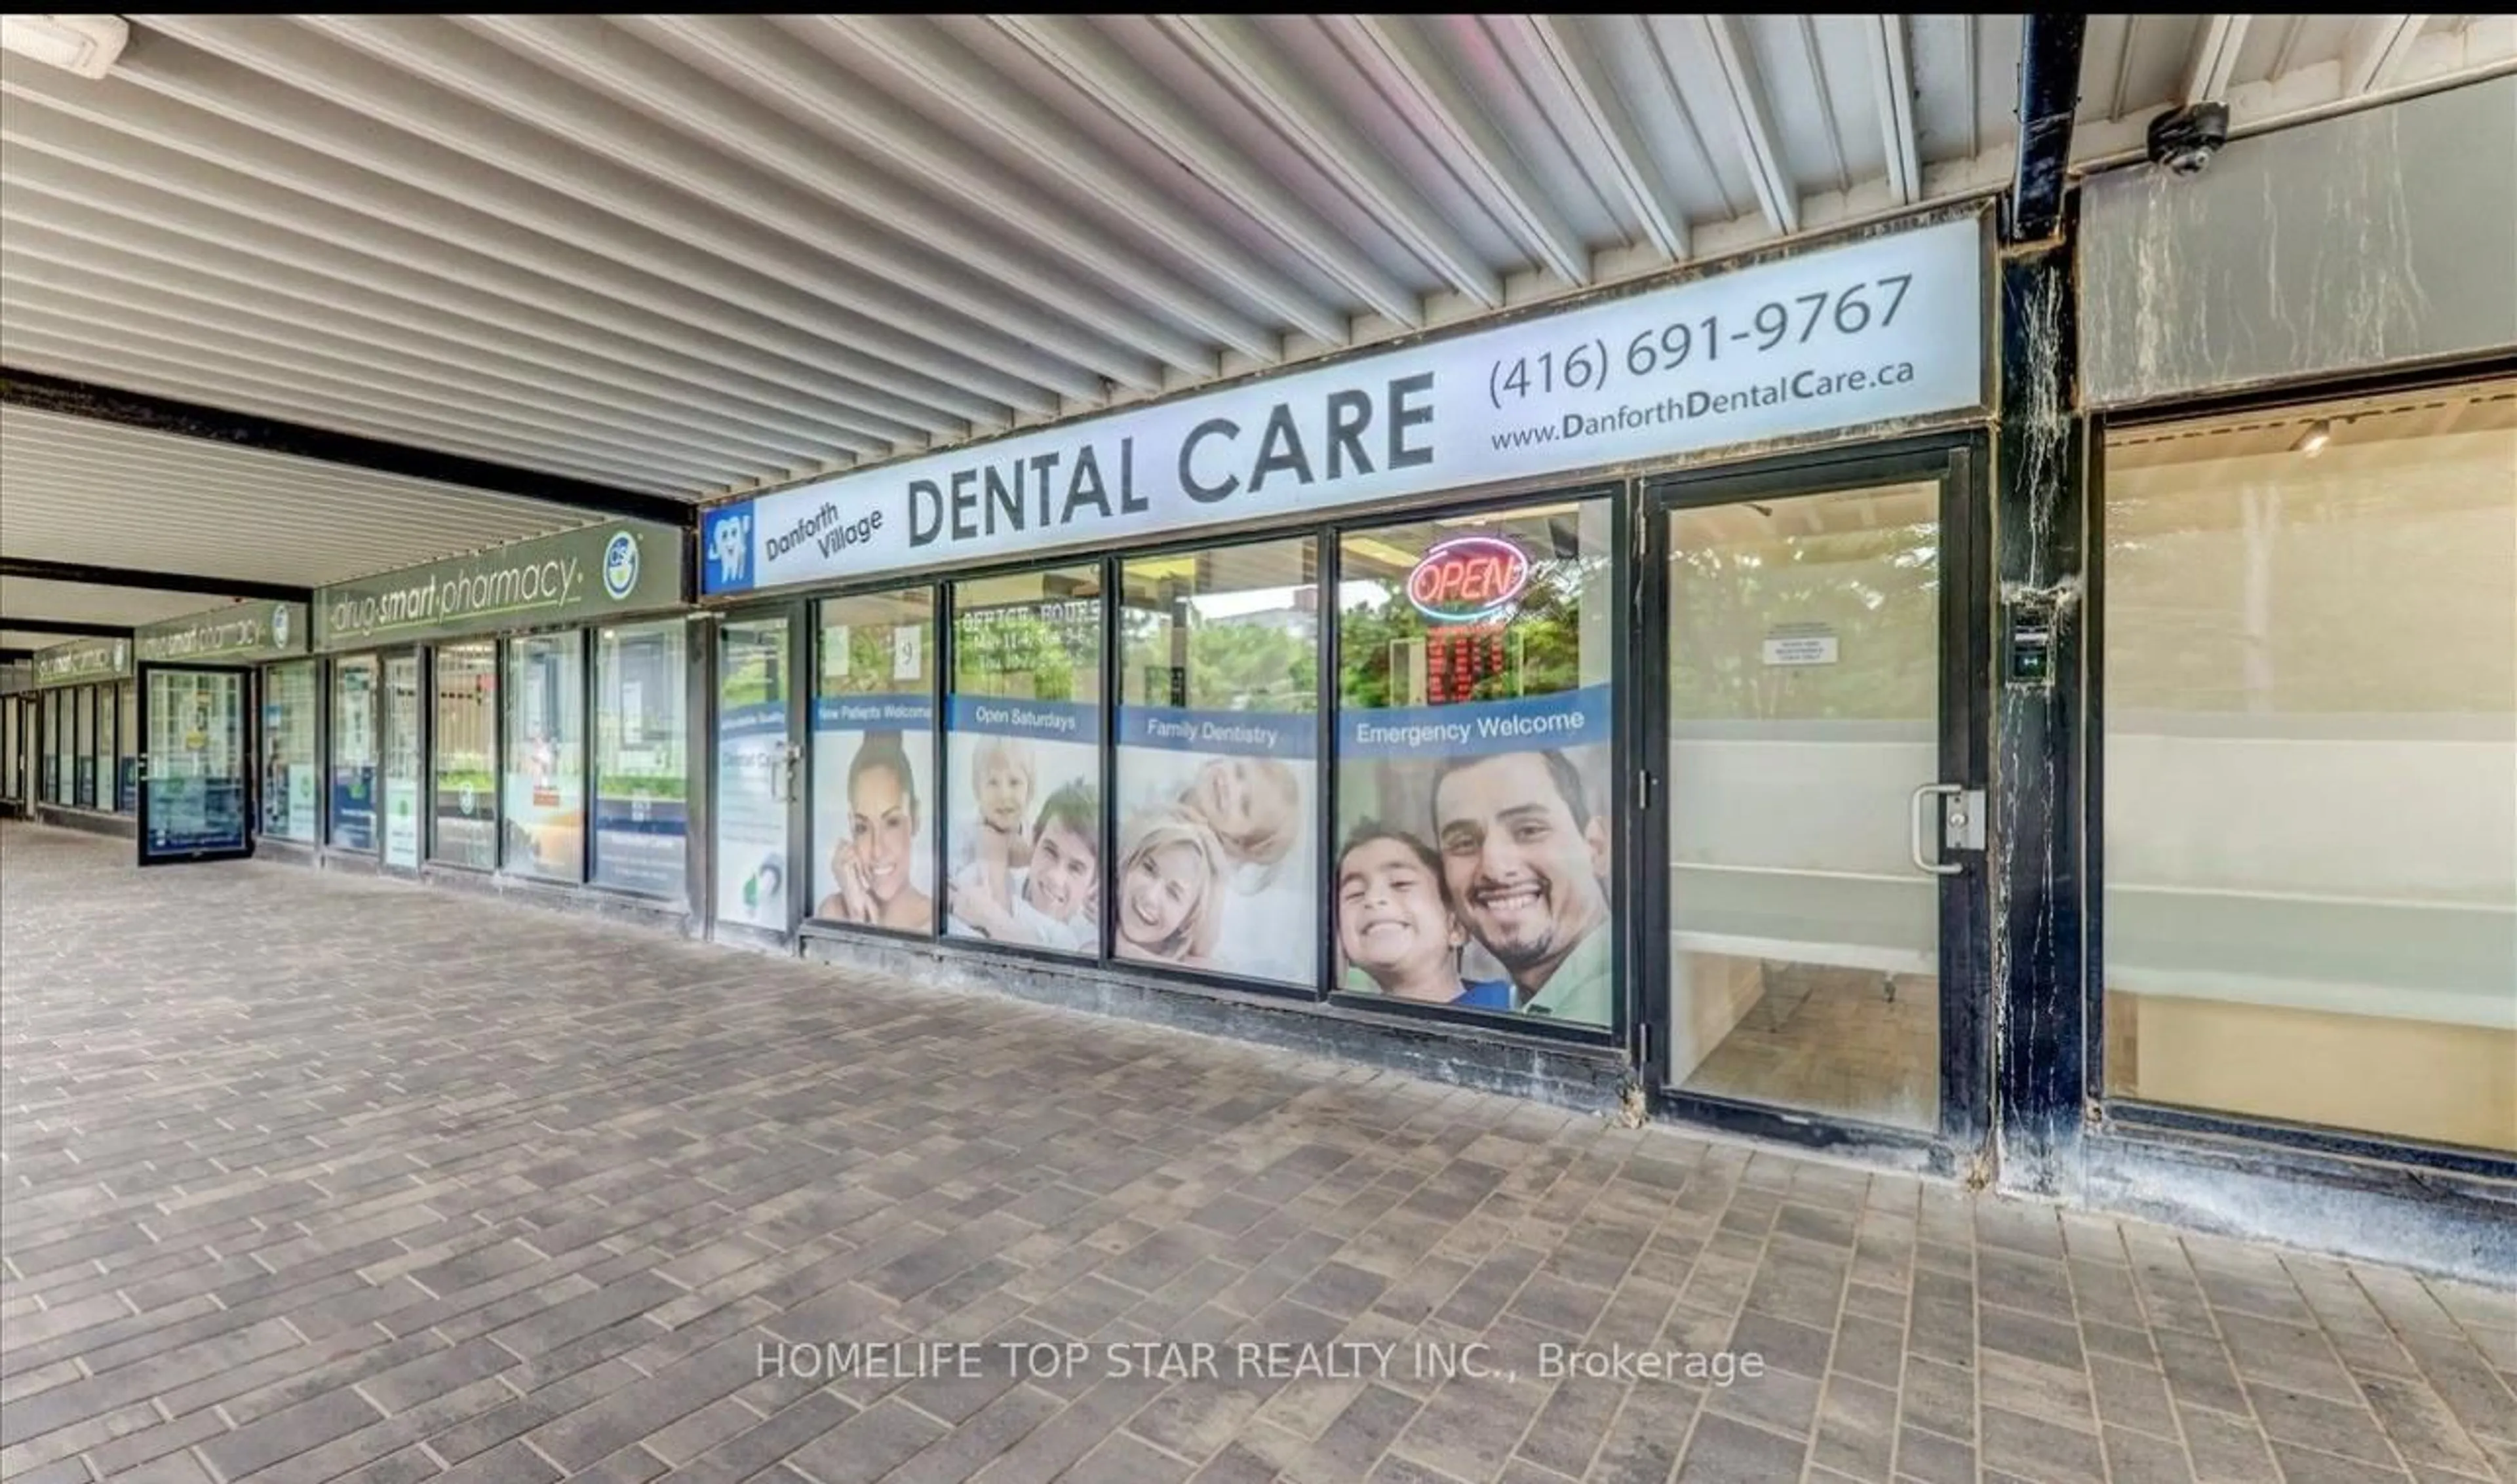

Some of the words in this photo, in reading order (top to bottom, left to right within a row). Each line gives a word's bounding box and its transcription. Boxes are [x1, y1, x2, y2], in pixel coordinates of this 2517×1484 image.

[1489, 339, 1609, 410] (416)
[1626, 273, 1913, 376] 691-9767
[1491, 358, 1915, 452] www.DanforthDentalCare.ca
[908, 436, 1148, 548] DENTAL
[1179, 371, 1435, 505] CARE
[766, 501, 839, 562] Danforth
[817, 509, 883, 559] Village
[1414, 555, 1515, 602] OPEN
[840, 705, 881, 720] Patients
[884, 703, 932, 719] Welcome
[975, 706, 1009, 723] Open
[1011, 709, 1077, 732] Saturdays
[1147, 718, 1198, 741] Family
[1202, 722, 1279, 749] Dentistry
[1356, 722, 1471, 747] Emergency
[1476, 710, 1585, 739] Welcome
